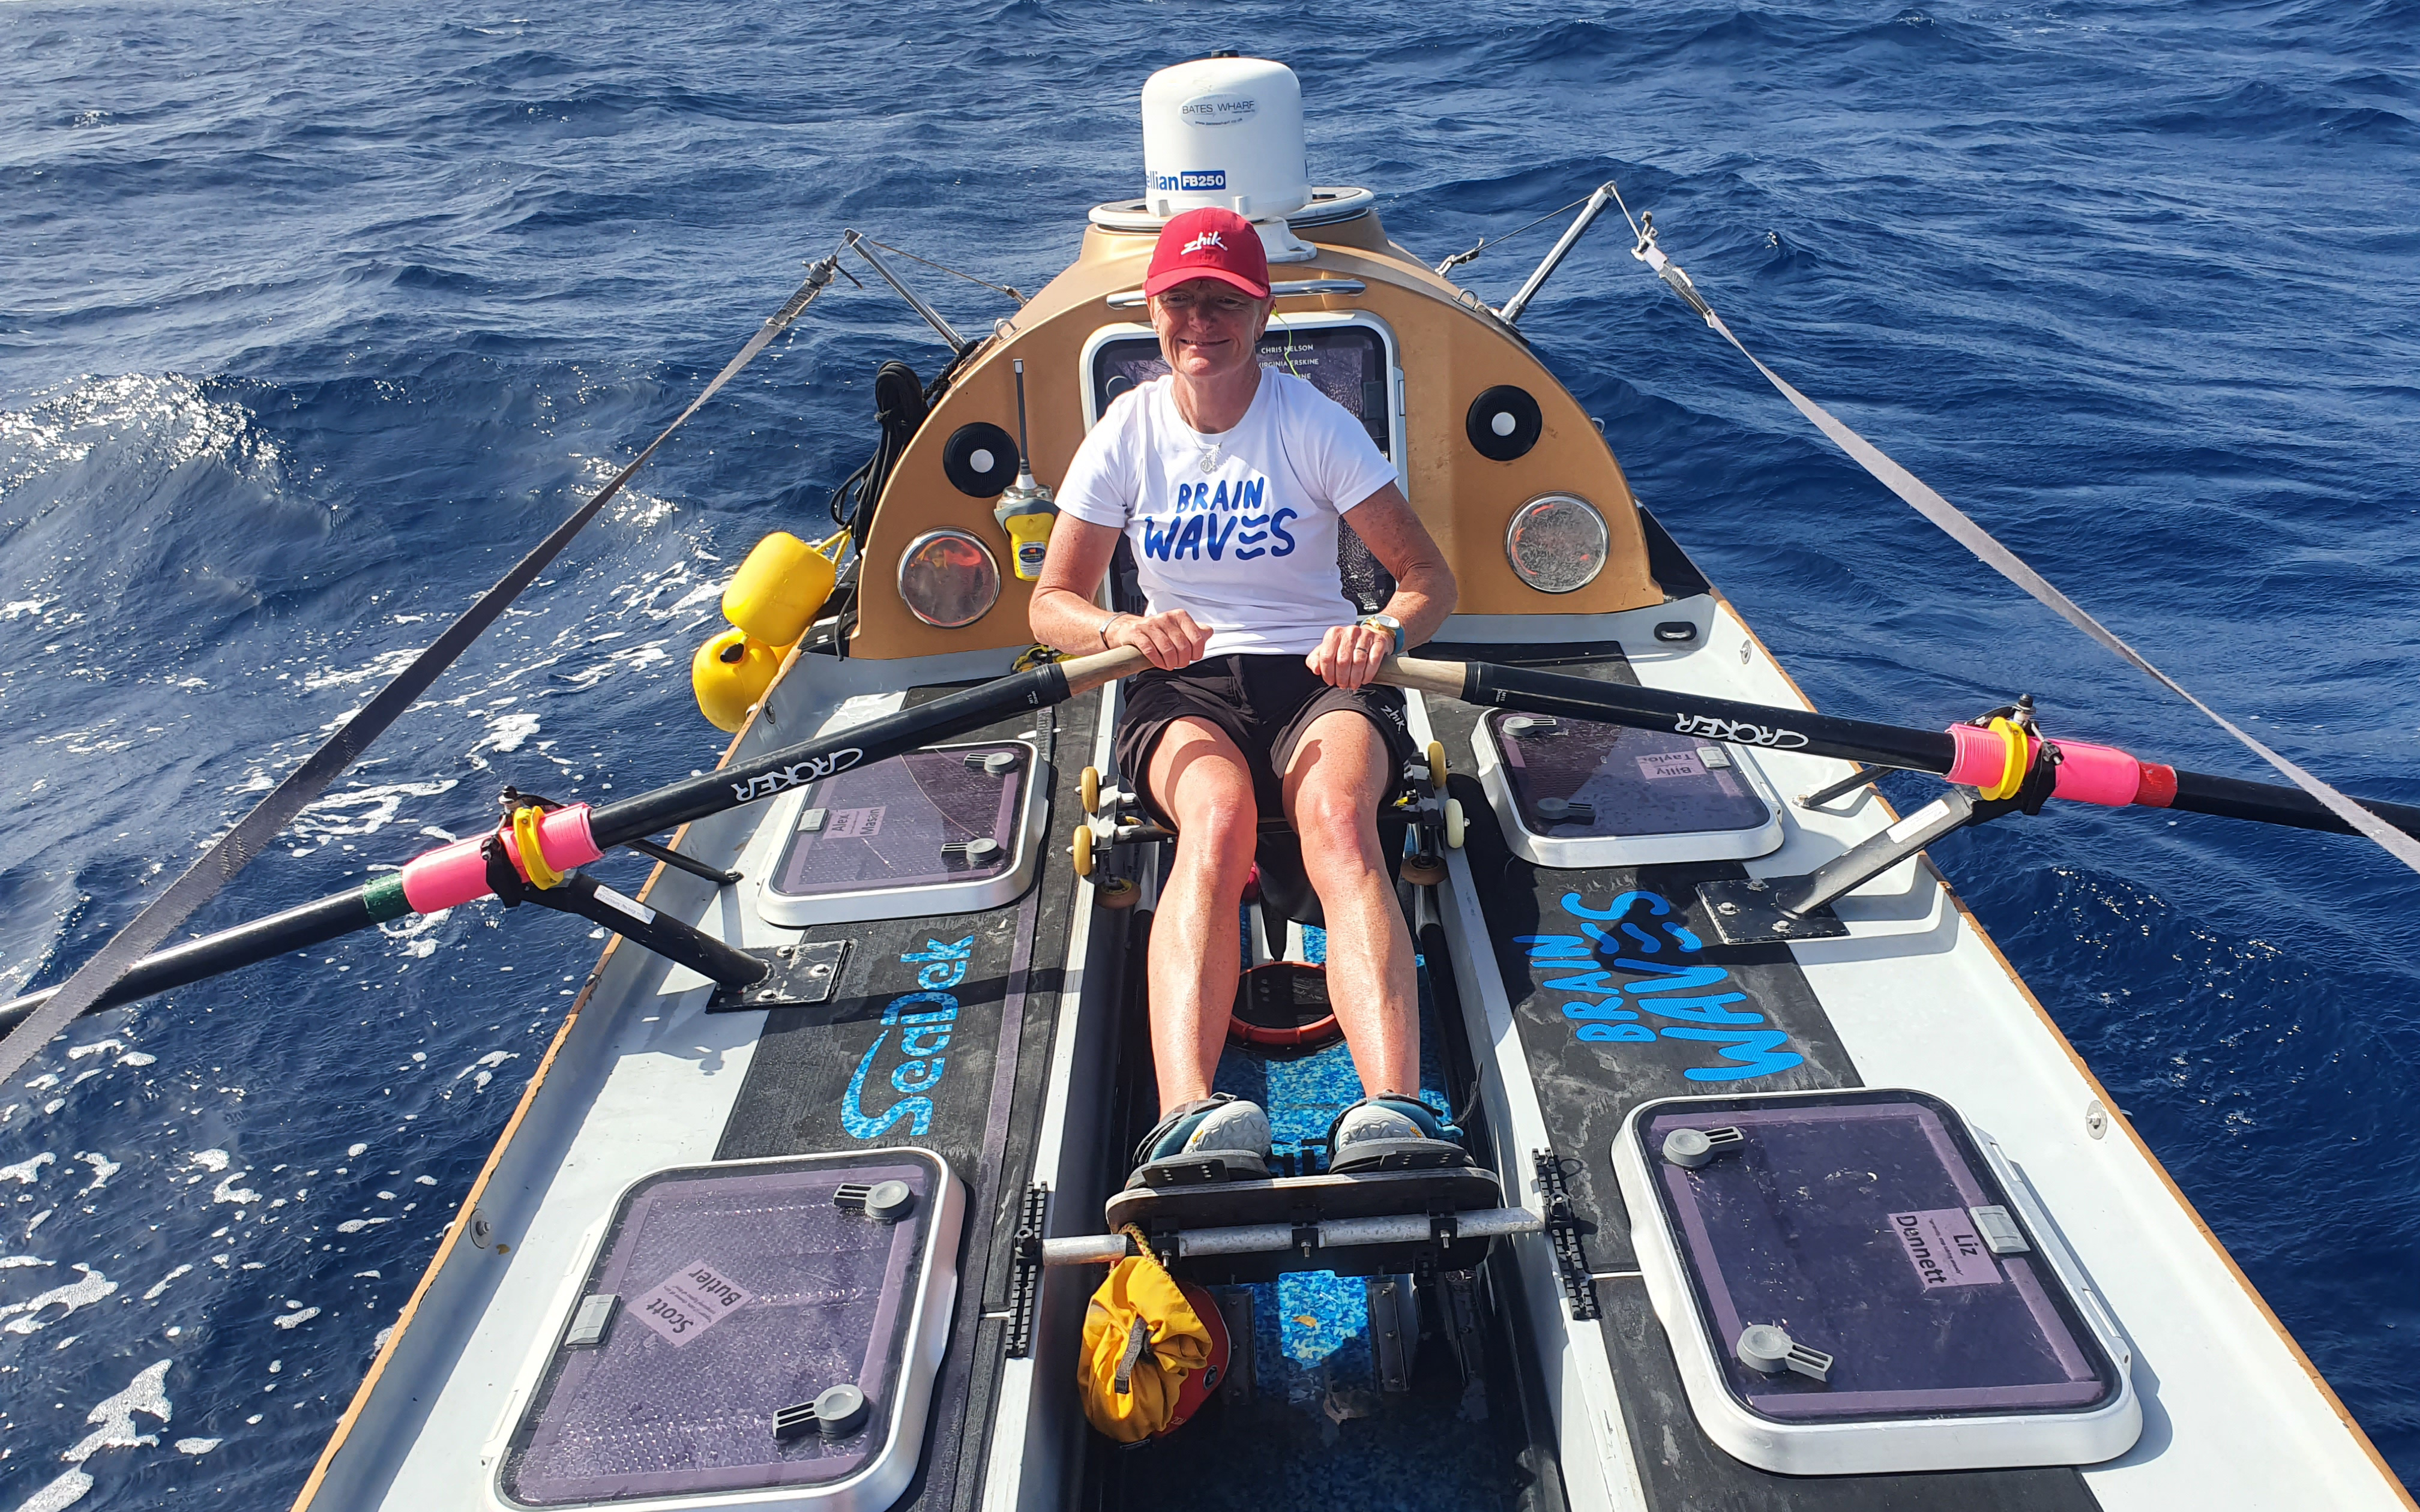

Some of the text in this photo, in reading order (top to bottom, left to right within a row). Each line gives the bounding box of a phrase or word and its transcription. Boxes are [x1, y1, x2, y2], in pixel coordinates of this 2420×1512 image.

[1182, 104, 1213, 114] BATES
[1217, 100, 1254, 112] WHARF
[1182, 175, 1224, 187] FB250
[1181, 230, 1228, 255] zhik
[1284, 344, 1313, 352] NELSON
[1176, 477, 1264, 514] BRAIN
[1145, 508, 1298, 562] WAVES
[1380, 705, 1404, 734] zhik
[1675, 713, 1809, 748] CROKER
[730, 748, 863, 801] CROKER
[1657, 766, 1691, 775] Billy
[832, 814, 849, 832] Alex
[859, 809, 880, 835] Mason
[1512, 935, 1656, 1042] BRAIN
[1561, 890, 1804, 1081] WAVES
[841, 935, 974, 1139] SeaDek
[1896, 1215, 1947, 1283] Dennett
[1953, 1234, 1978, 1256] Liz
[688, 1269, 742, 1306] Butler
[646, 1298, 693, 1333] Scott
